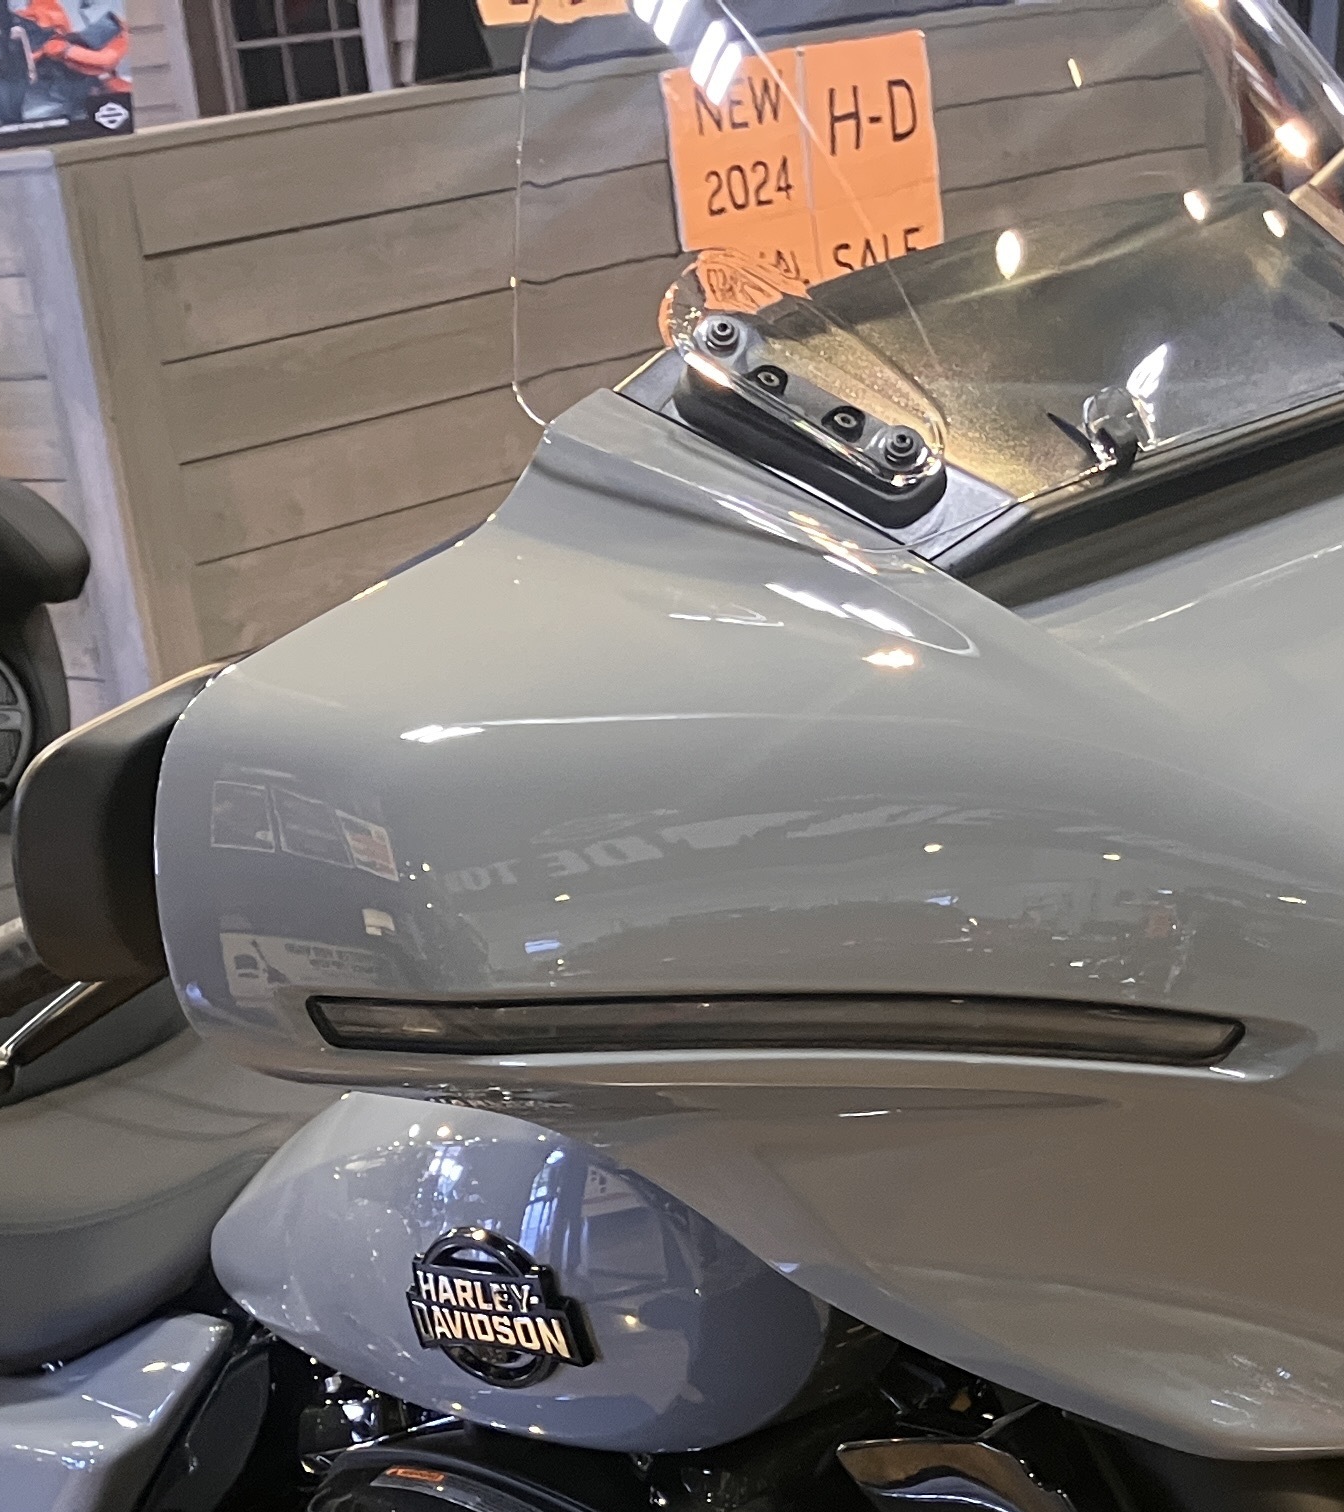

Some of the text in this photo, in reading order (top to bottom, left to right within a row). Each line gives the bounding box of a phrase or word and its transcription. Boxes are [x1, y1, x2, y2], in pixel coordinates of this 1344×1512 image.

[693, 69, 918, 157] NEW H-D
[705, 155, 794, 217] 2024
[416, 1270, 540, 1314] HARLEY-
[411, 1300, 572, 1359] DAVIDSON
